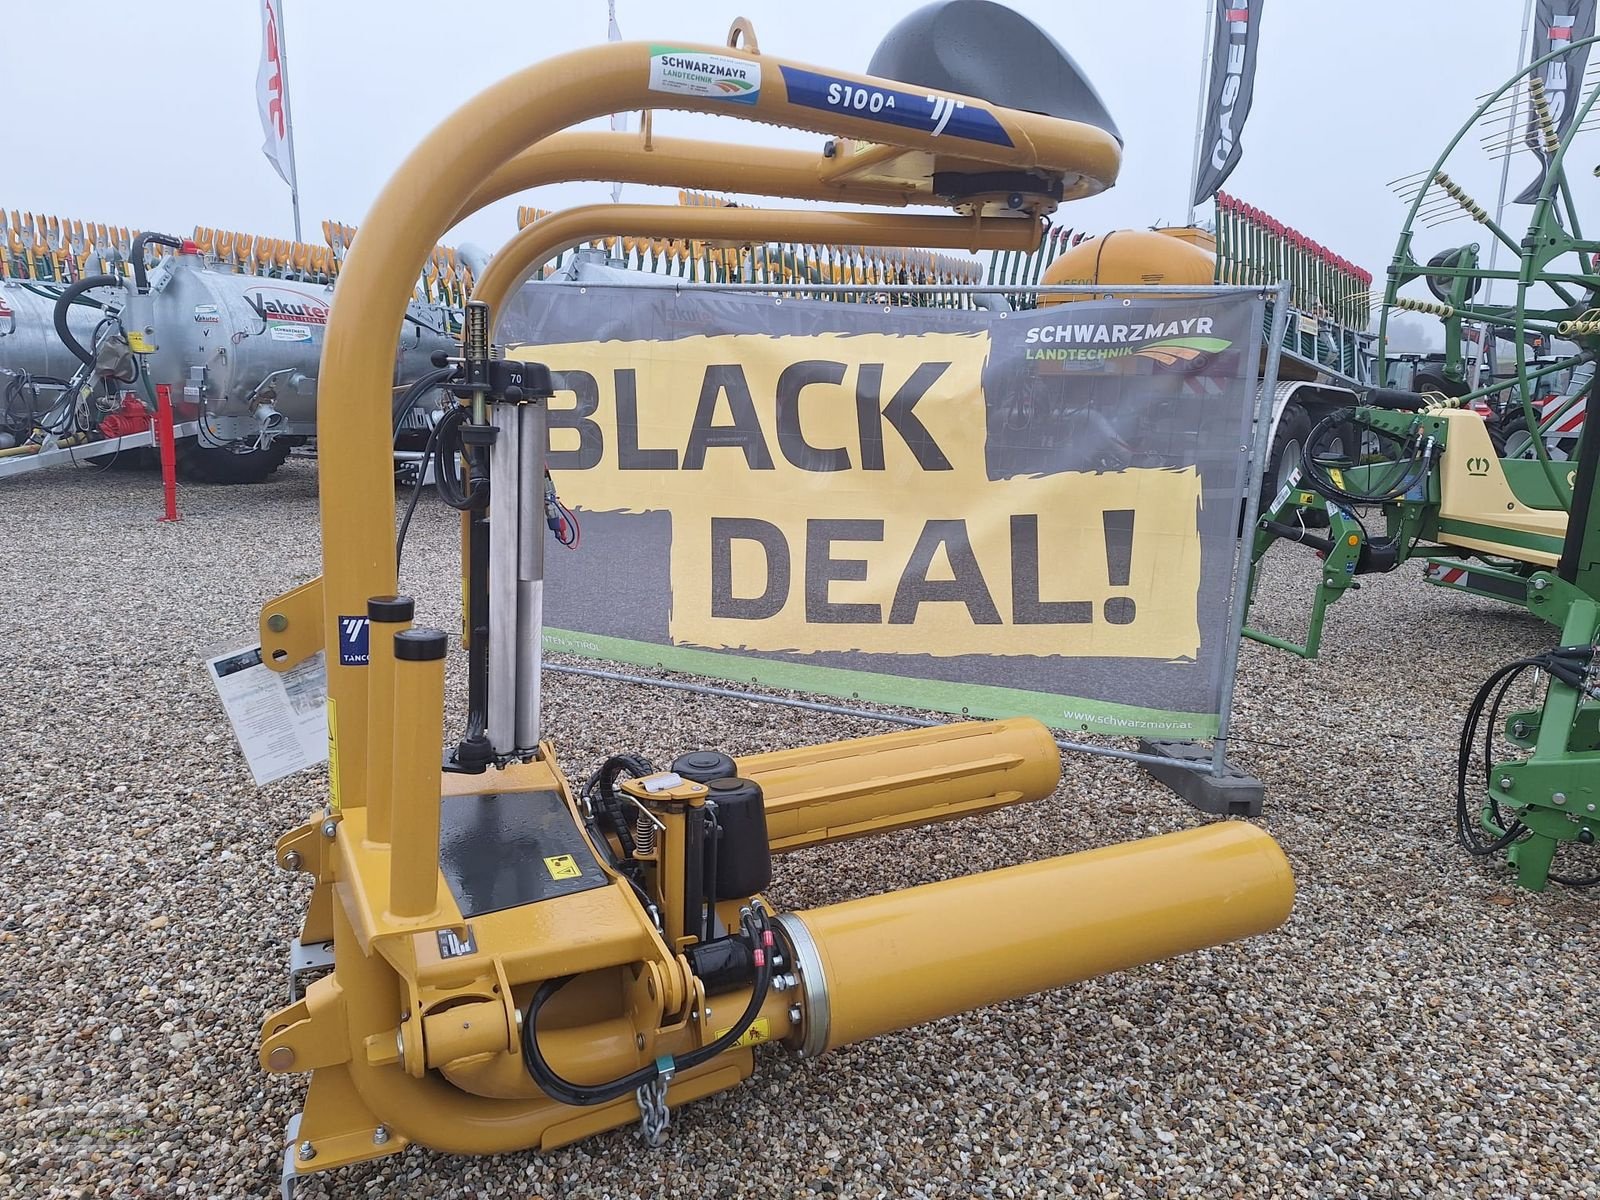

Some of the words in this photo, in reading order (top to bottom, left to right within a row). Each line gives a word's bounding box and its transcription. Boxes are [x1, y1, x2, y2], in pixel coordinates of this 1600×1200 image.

[661, 55, 747, 80] SCHWARZMAYR
[662, 68, 713, 84] LANDTECHNIK
[1025, 317, 1213, 344] SCHWARZMAYR
[1025, 346, 1134, 361] LANDTECHNIK
[511, 374, 522, 384] 70
[548, 360, 954, 472] BLACK
[711, 509, 1137, 625] DEAL!
[1063, 709, 1193, 730] www.schwarzmayr.at
